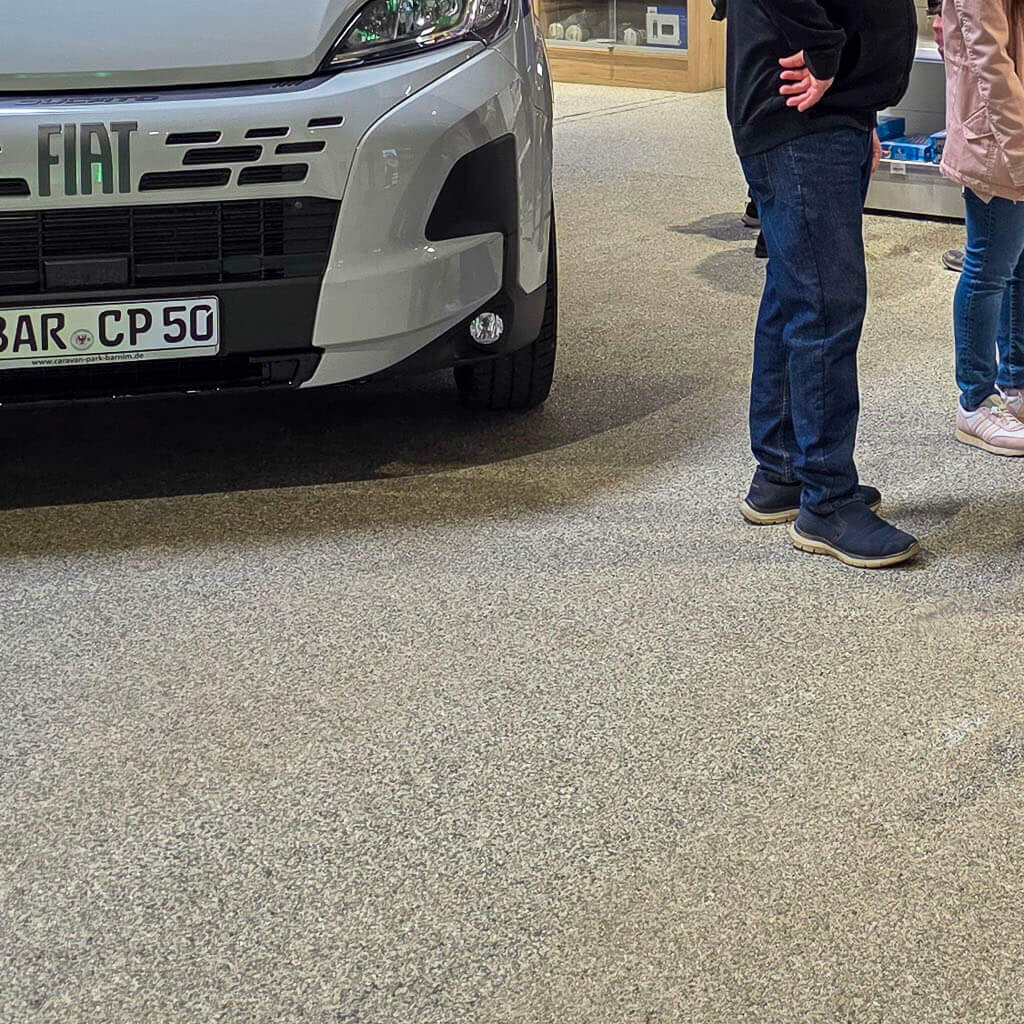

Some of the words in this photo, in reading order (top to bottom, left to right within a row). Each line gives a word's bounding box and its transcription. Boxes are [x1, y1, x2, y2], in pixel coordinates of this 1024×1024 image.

[38, 120, 138, 197] FIAT
[98, 308, 153, 347] CP
[163, 304, 214, 344] 50
